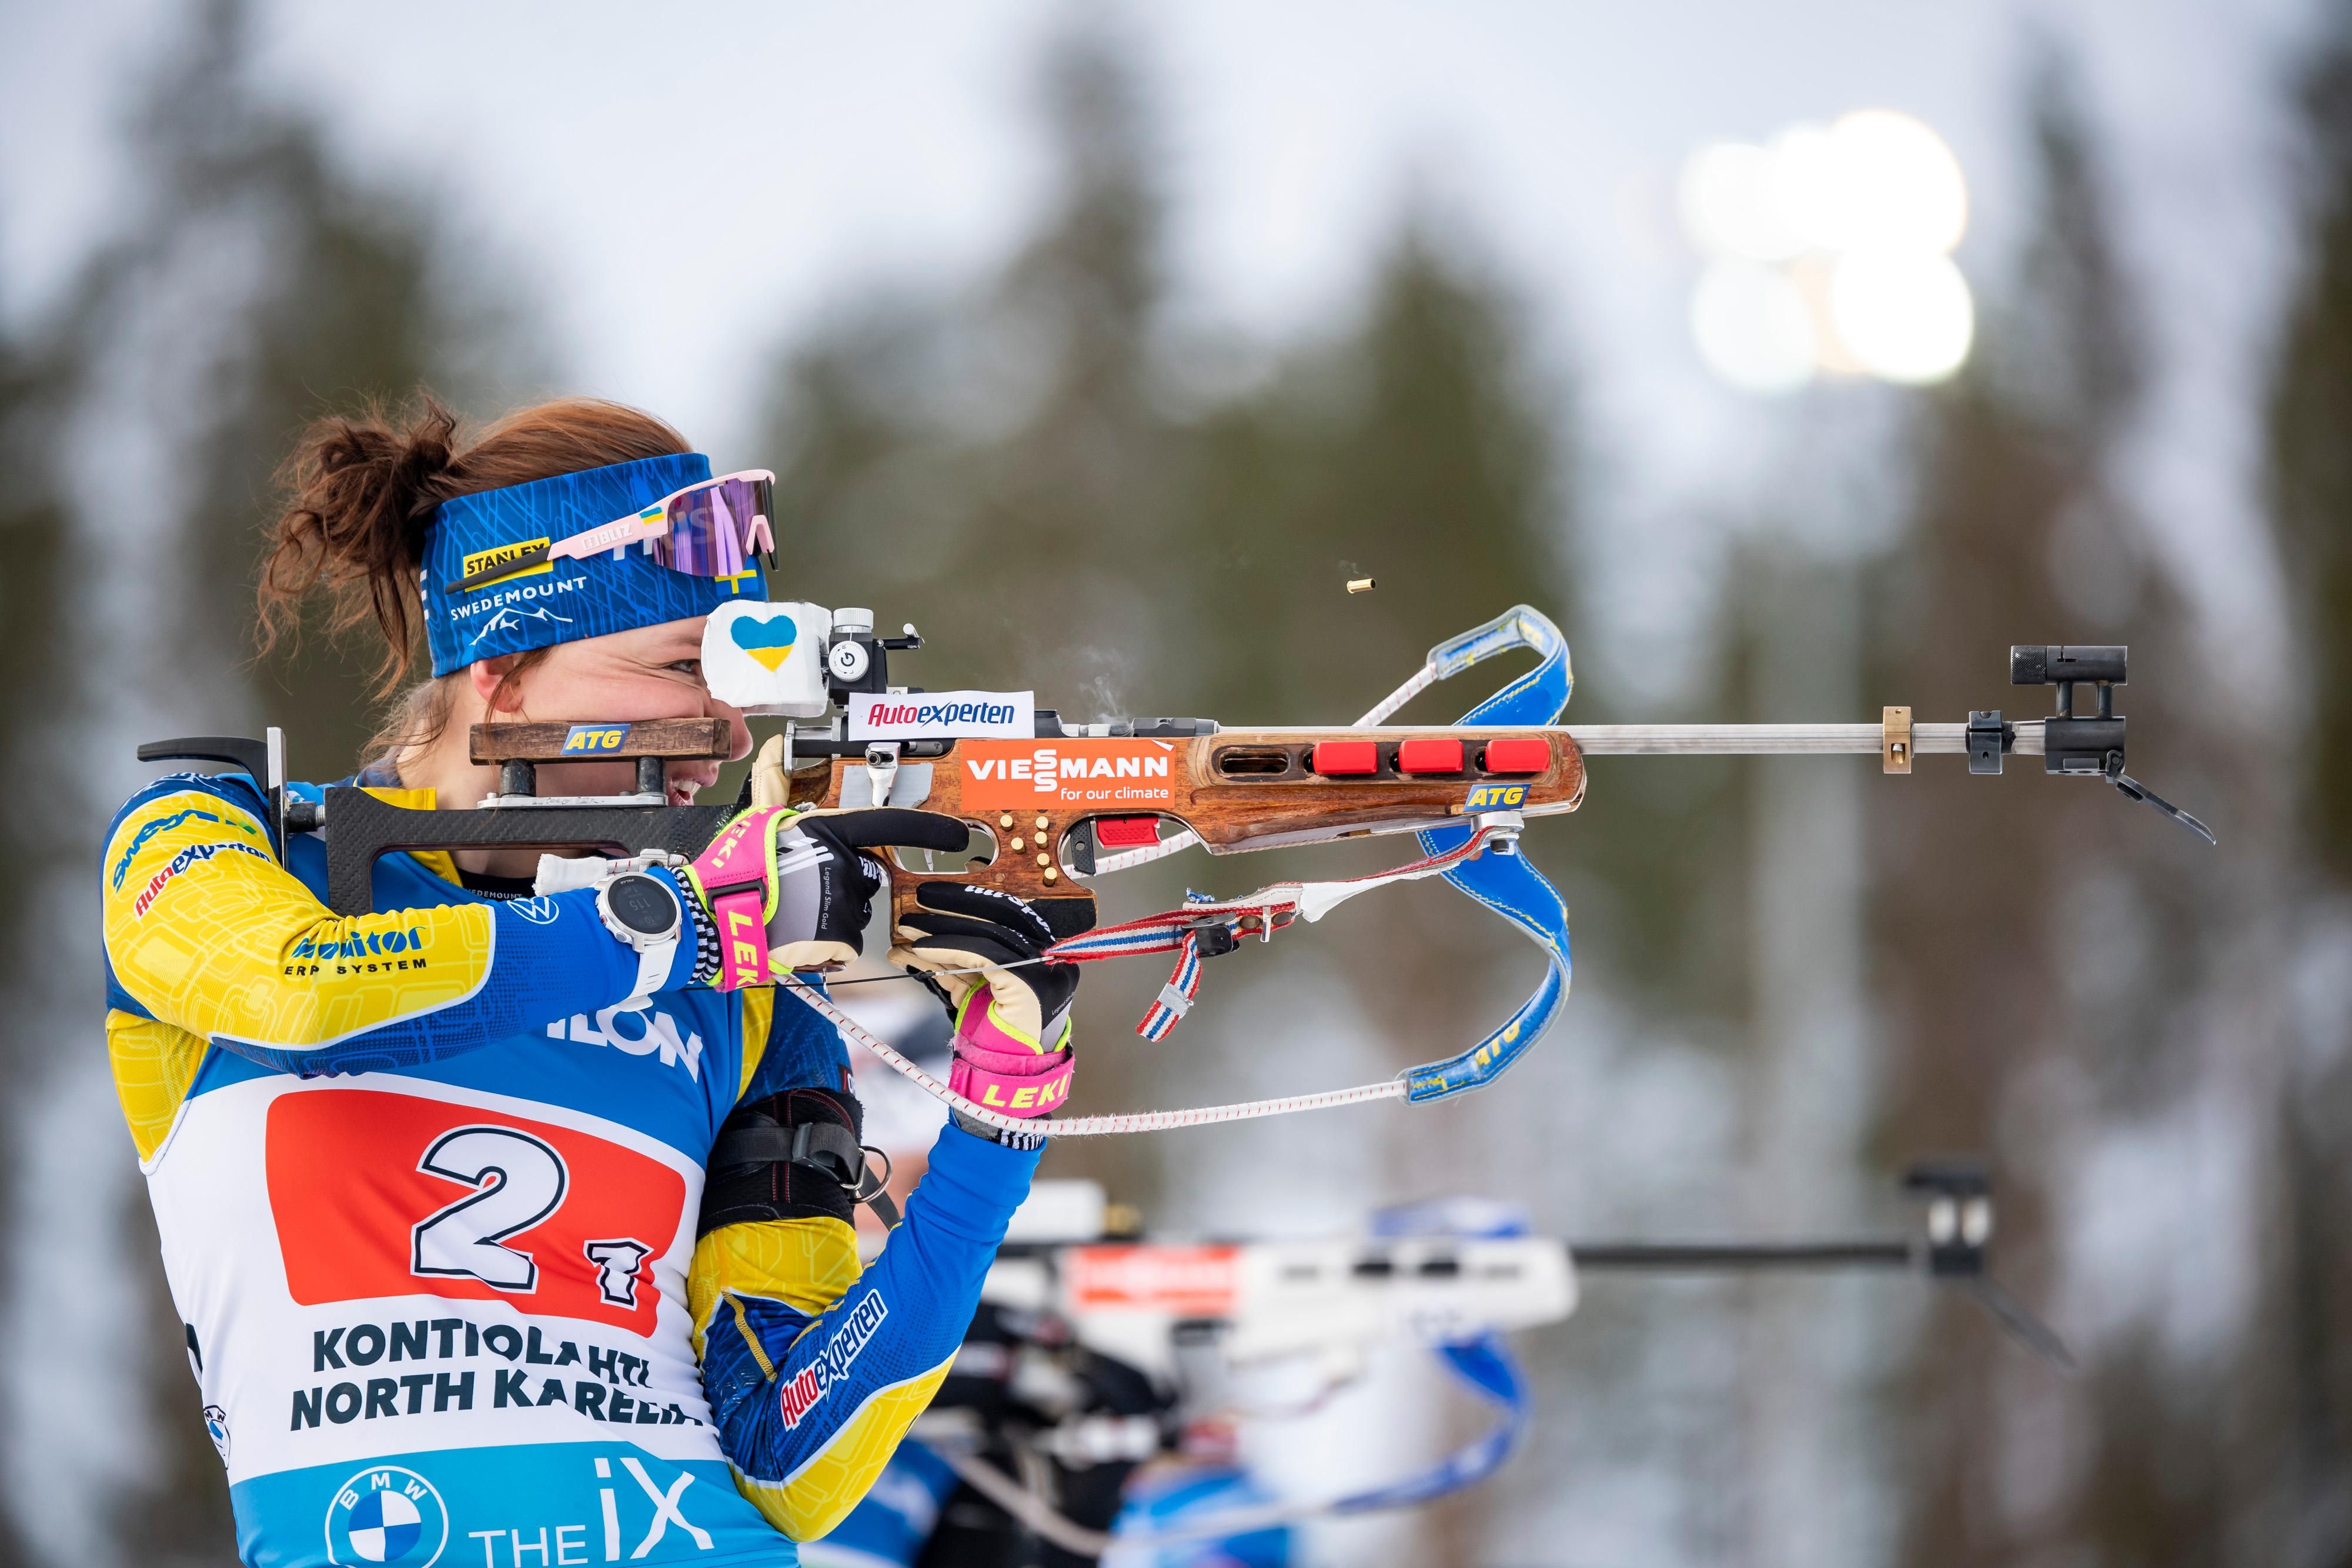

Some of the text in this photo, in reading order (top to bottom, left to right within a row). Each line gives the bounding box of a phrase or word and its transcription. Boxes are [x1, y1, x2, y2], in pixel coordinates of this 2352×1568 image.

[599, 523, 633, 545] BLIZ
[450, 576, 587, 621] SWEDEMOUNT
[868, 700, 1014, 728] Autoexperten
[565, 730, 622, 750] ATG
[967, 749, 1168, 792] VIESSMANN
[1061, 787, 1169, 800] for our climate
[1467, 787, 1524, 806] ATG
[823, 867, 831, 895] Legend
[284, 958, 427, 976] ERP SYSTEM
[727, 911, 759, 987] LEK
[982, 1073, 1068, 1109] LEKI
[411, 1124, 569, 1293] 2
[583, 1238, 654, 1311] 1
[780, 1291, 885, 1427] Autoexperten
[290, 1370, 466, 1432] NORTH
[340, 1471, 428, 1511] BMW
[469, 1457, 714, 1566] THE iX
